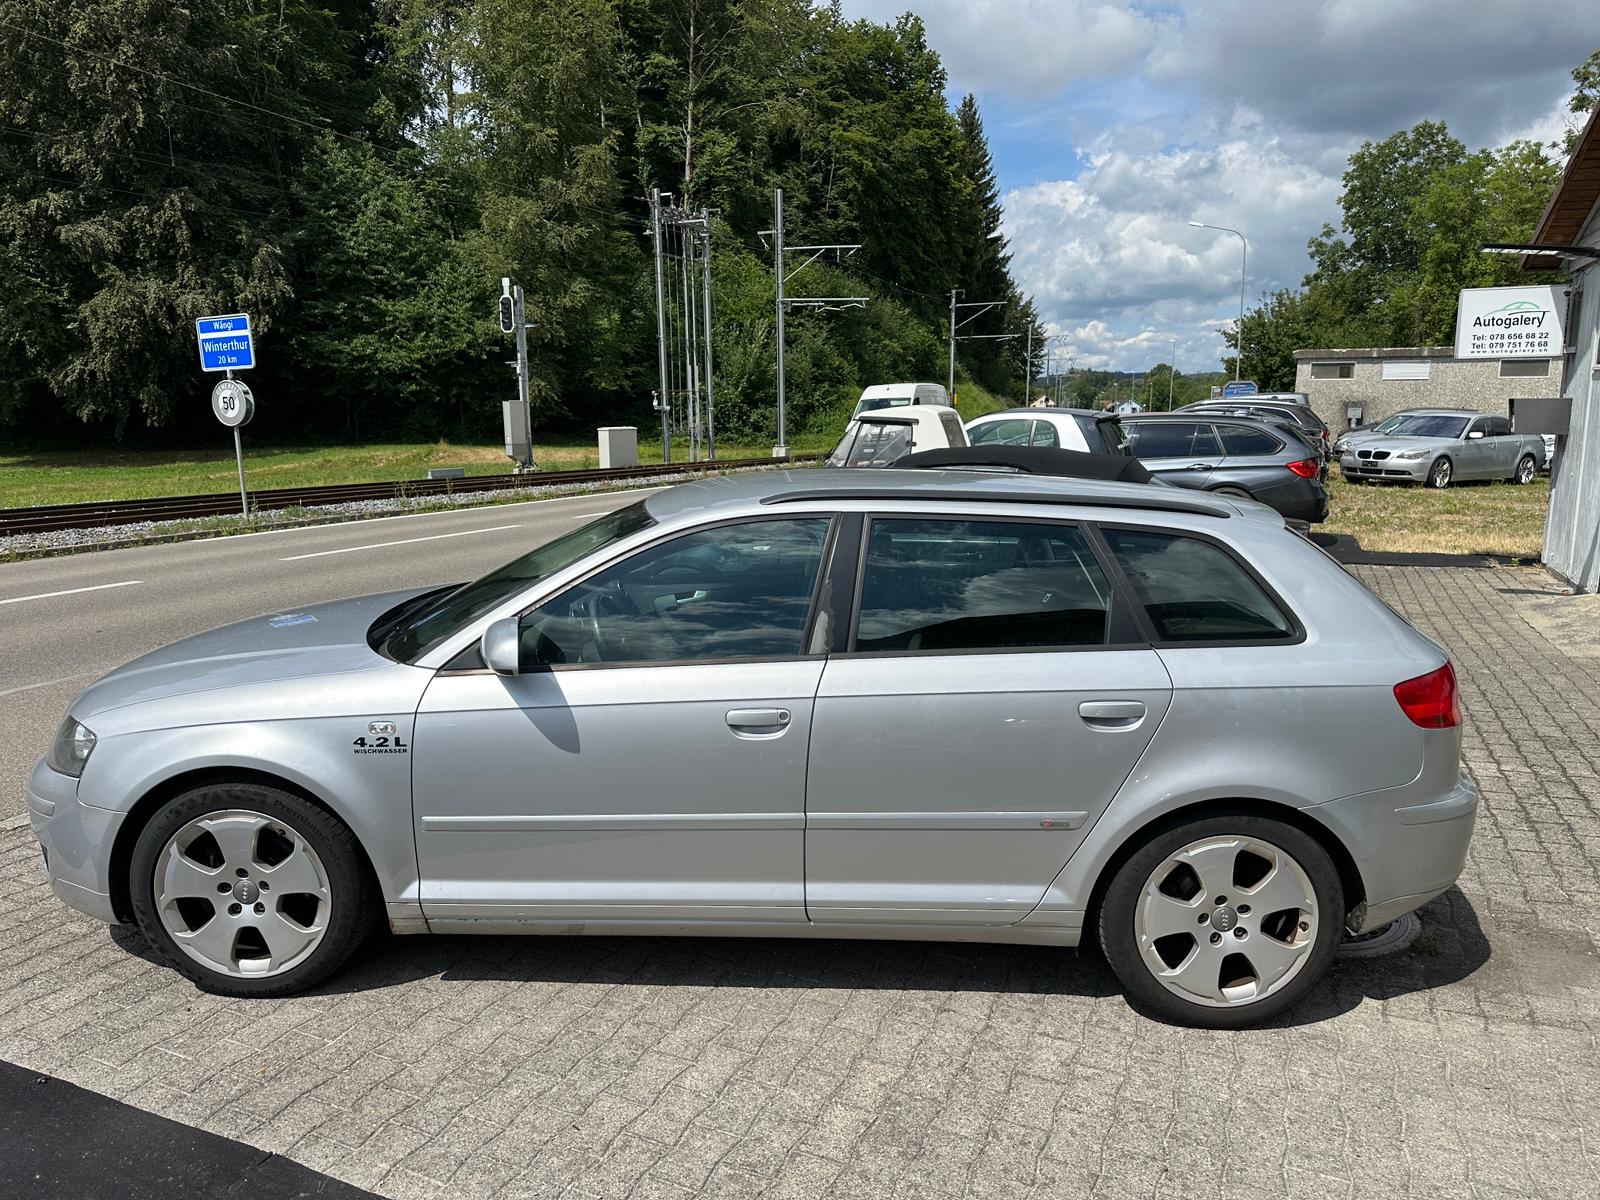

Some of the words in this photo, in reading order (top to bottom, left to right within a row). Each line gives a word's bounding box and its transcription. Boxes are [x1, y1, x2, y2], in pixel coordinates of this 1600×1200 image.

[1473, 312, 1545, 329] Autogalery
[203, 340, 248, 352] Winterthur
[218, 356, 226, 364] 20
[228, 355, 237, 363] km
[223, 396, 235, 410] 50
